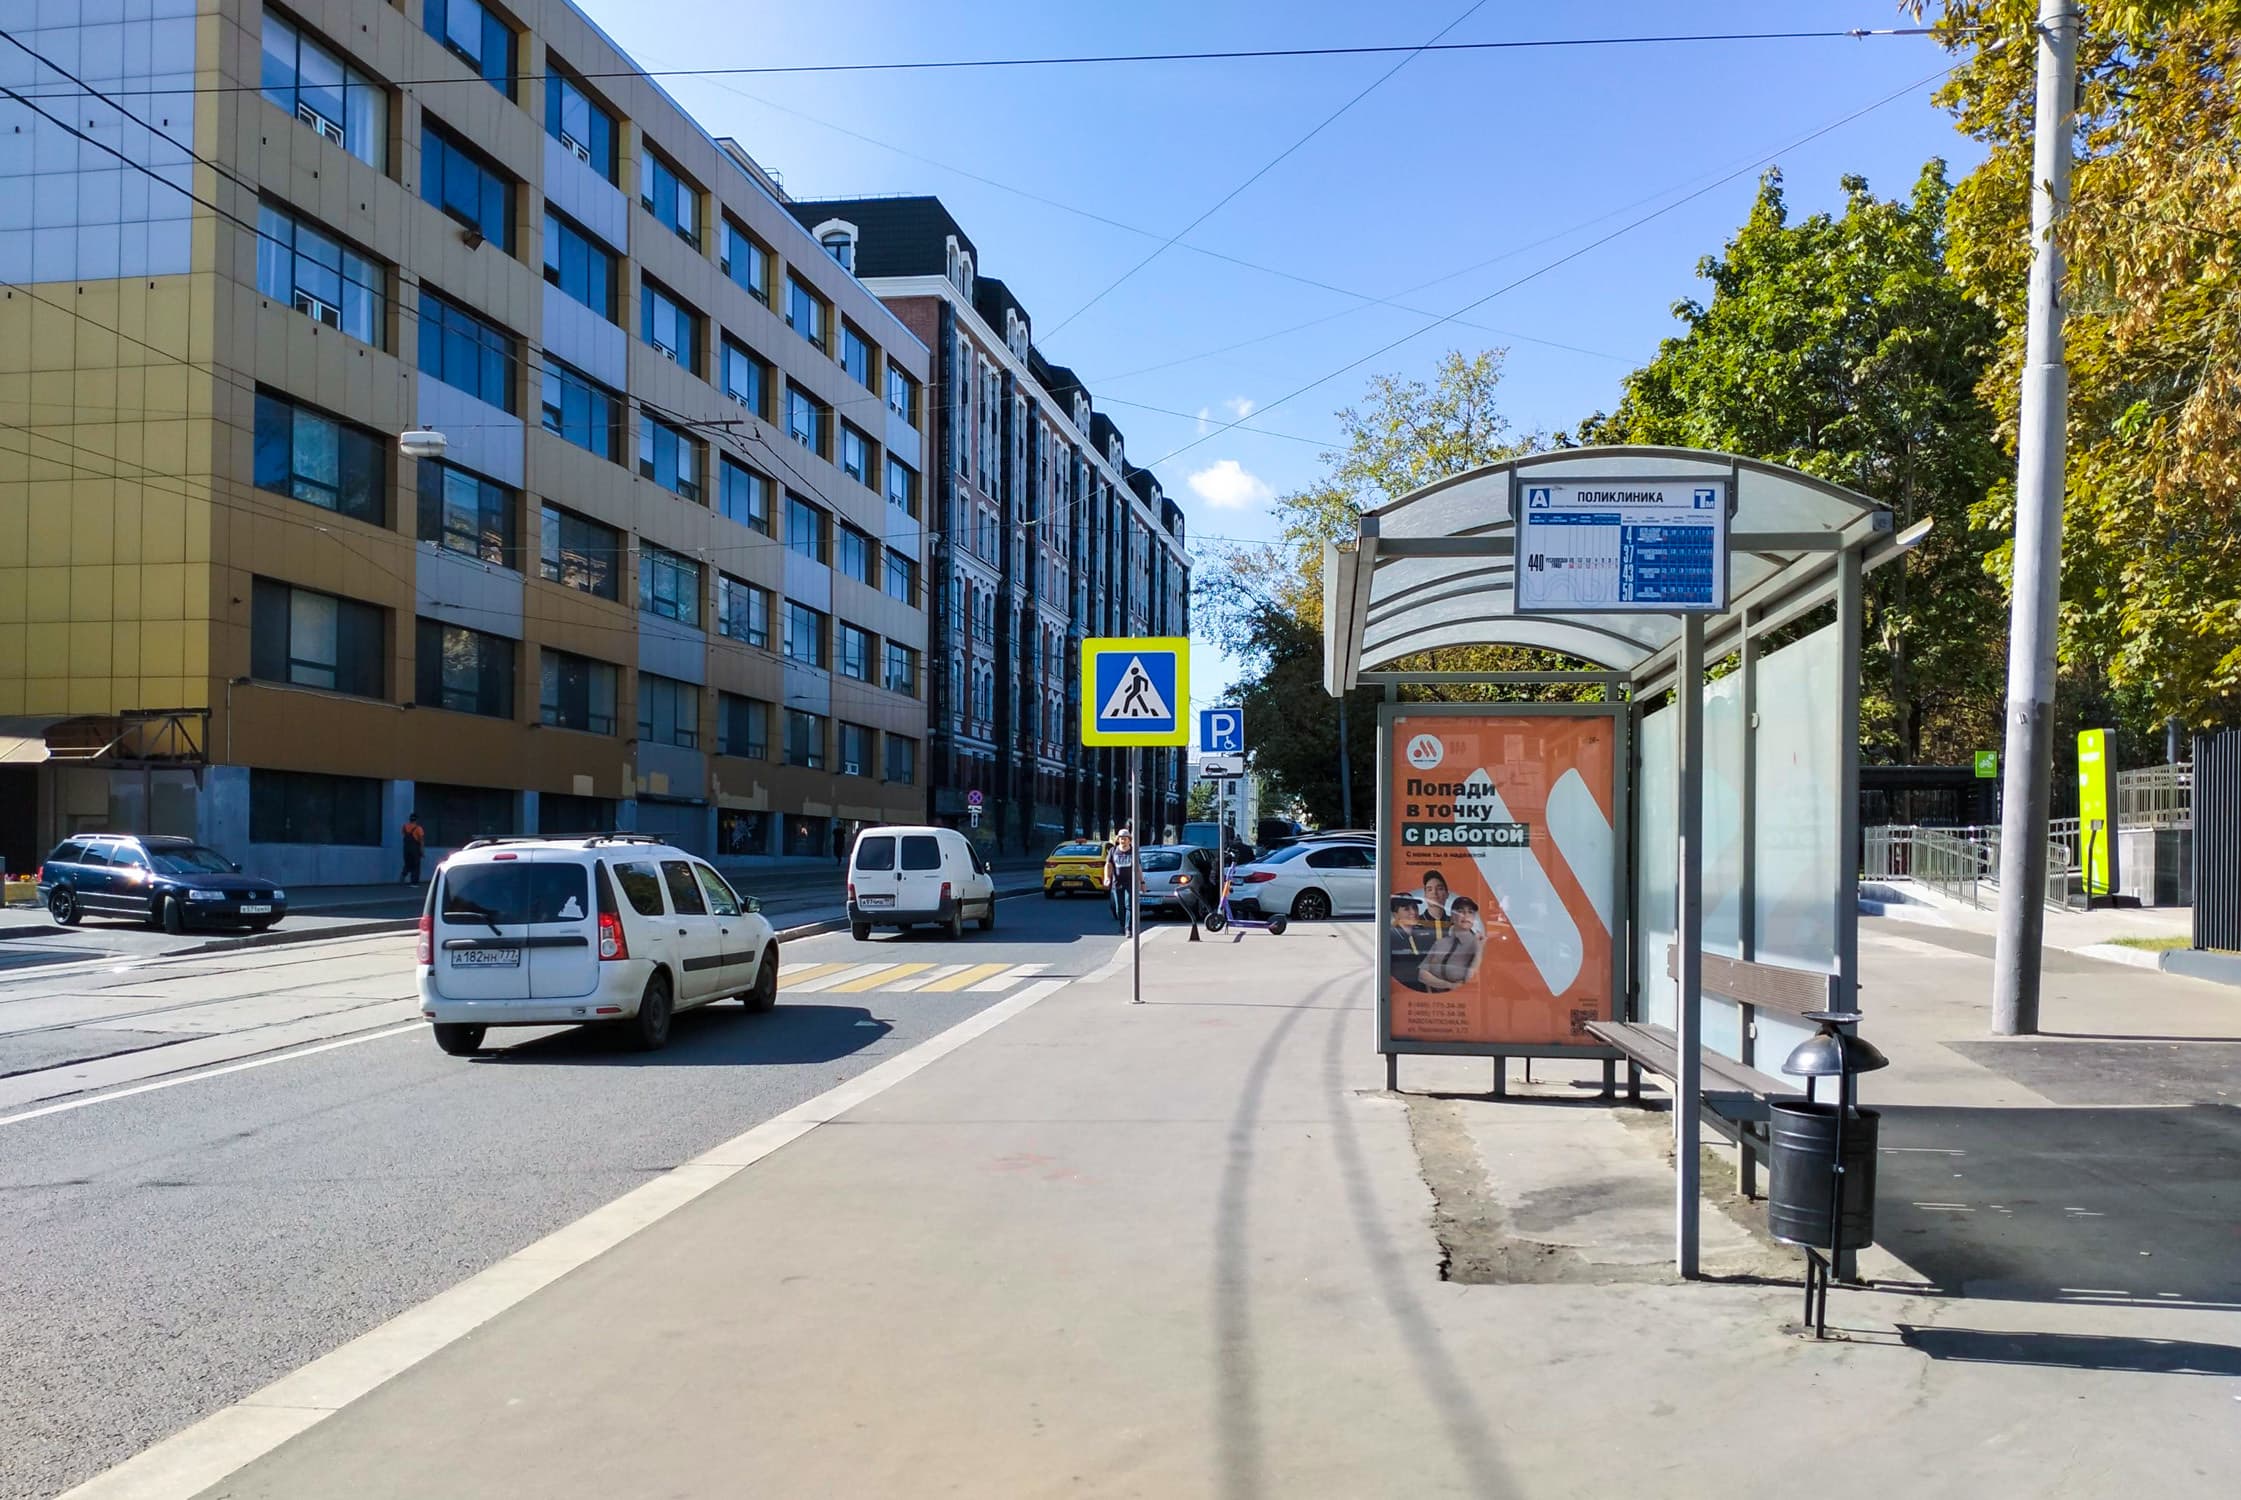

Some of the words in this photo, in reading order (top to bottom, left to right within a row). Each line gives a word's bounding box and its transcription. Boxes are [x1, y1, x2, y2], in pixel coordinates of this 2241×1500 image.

[1530, 490, 1548, 507] А
[1577, 491, 1664, 503] ПОЛИКЛИНИКА
[1626, 526, 1633, 544] 4
[1528, 554, 1544, 572] 440
[1623, 545, 1634, 564] 37
[1622, 564, 1634, 582] 43
[1622, 583, 1634, 601] 50
[1211, 714, 1235, 749] P
[1407, 779, 1495, 799] Попади
[1406, 804, 1420, 817] в
[1425, 804, 1493, 821] точку
[1405, 827, 1420, 842] с
[1424, 824, 1524, 845] работой
